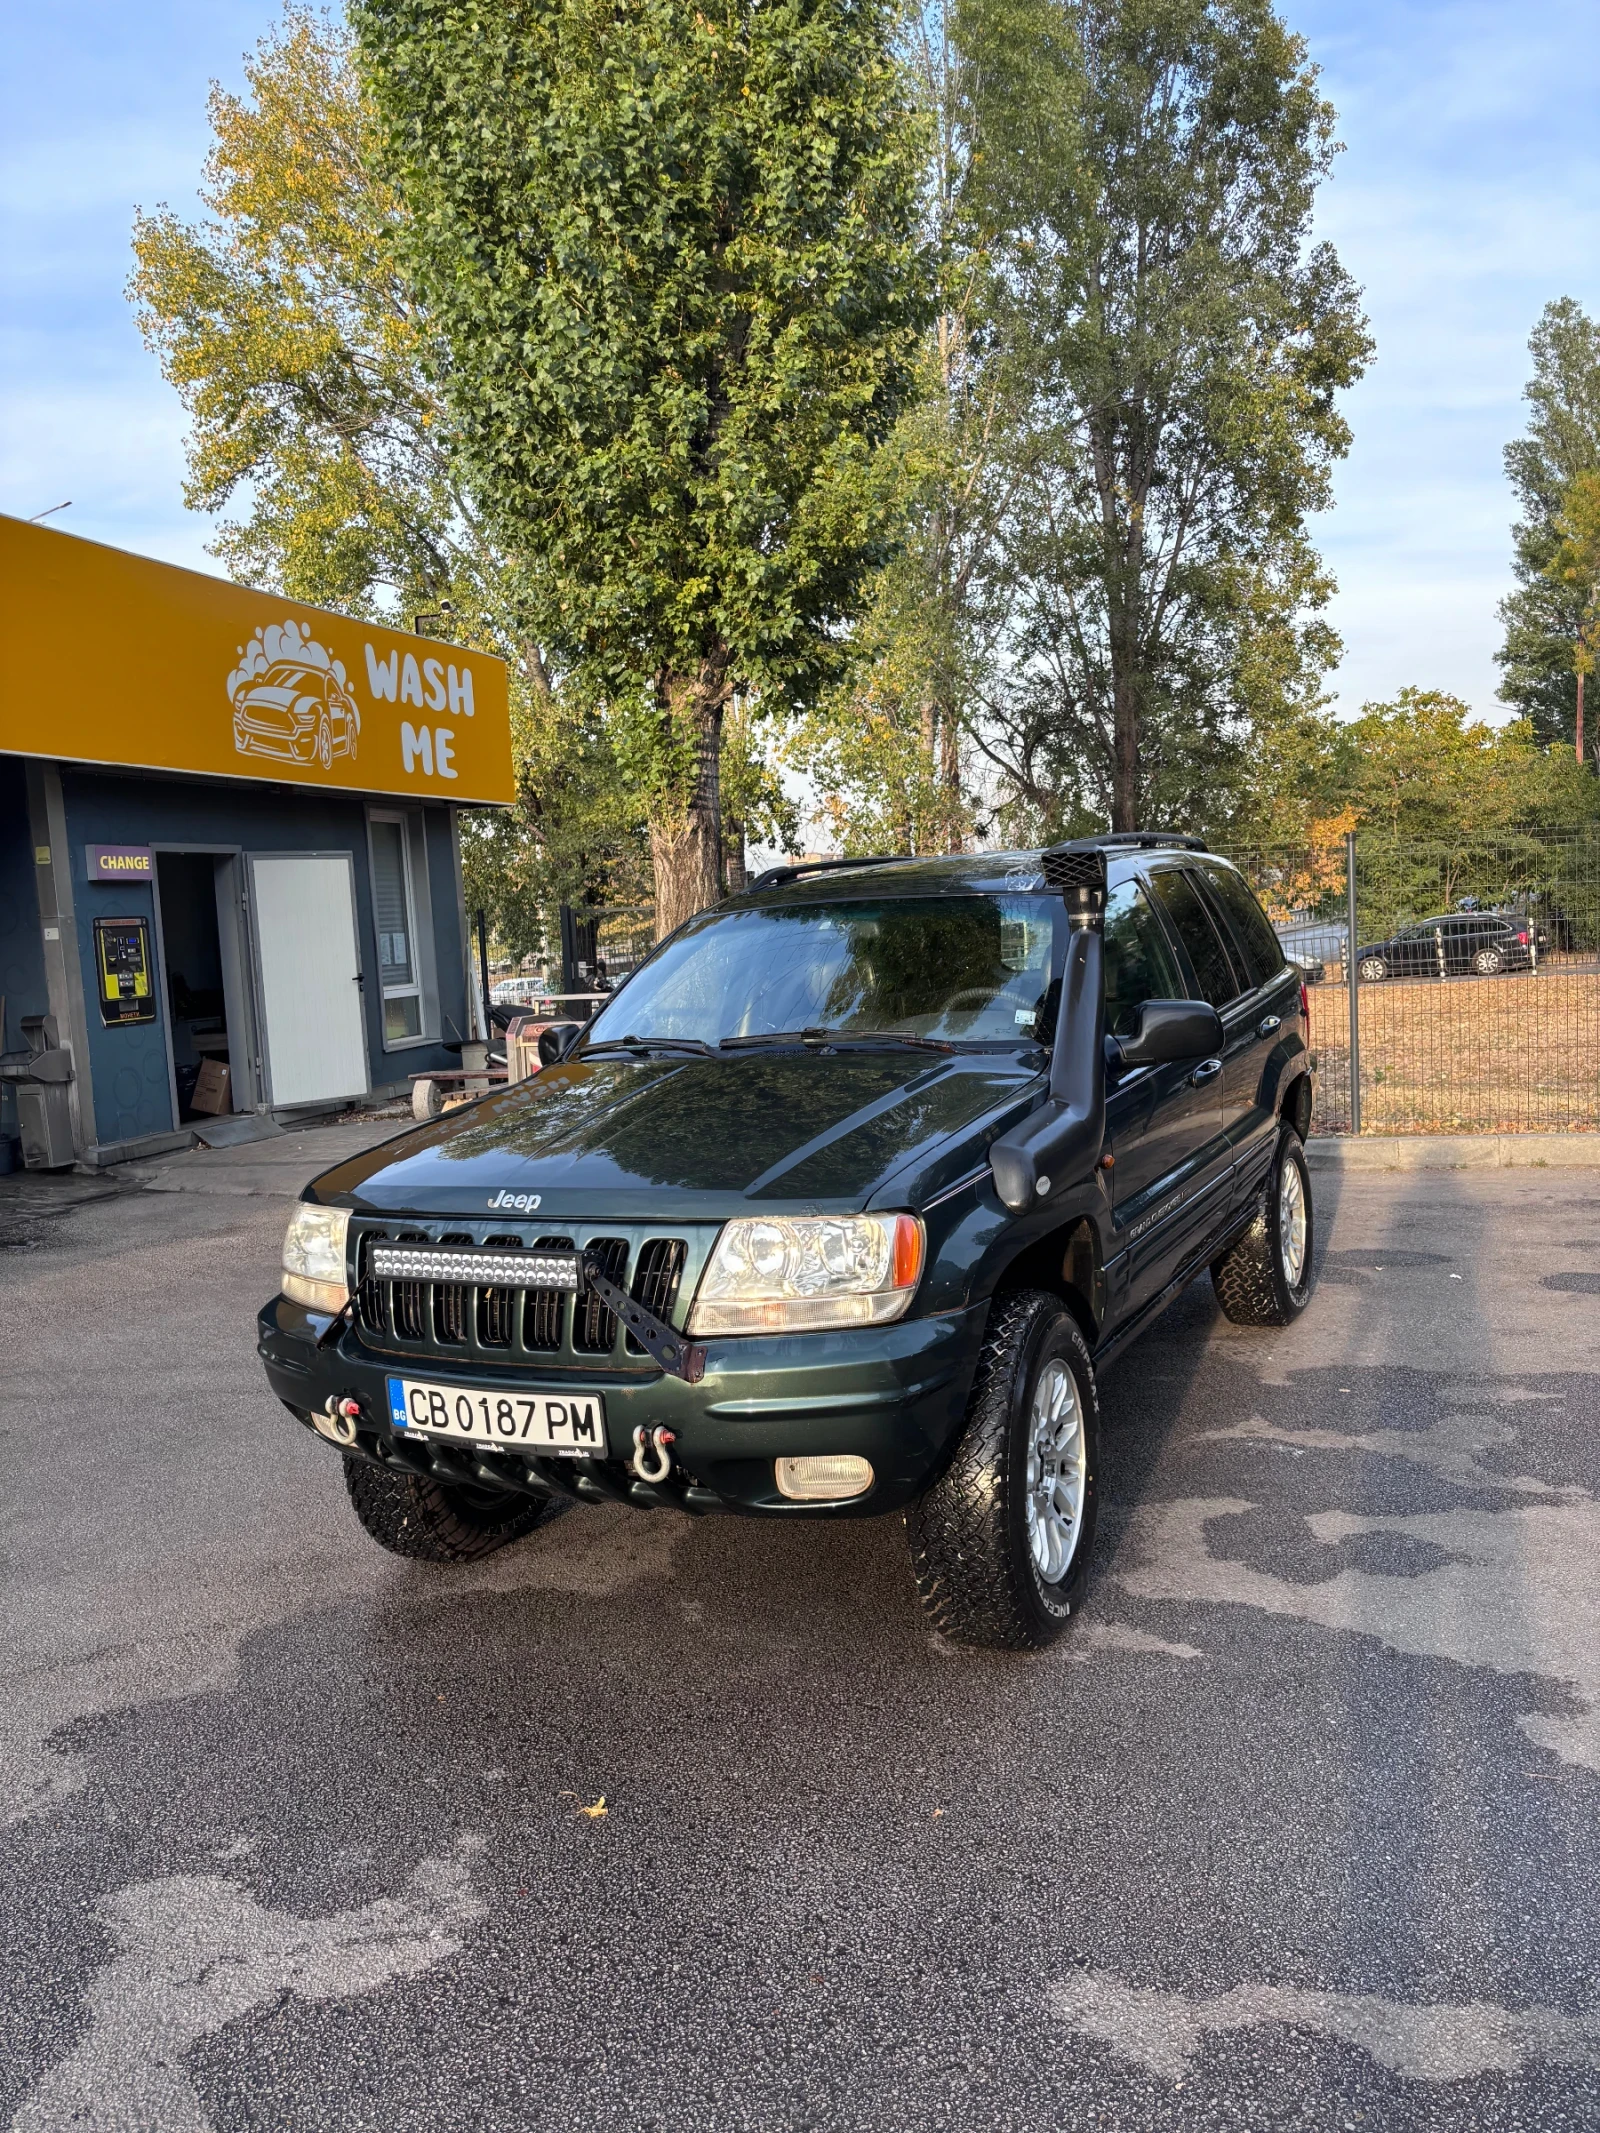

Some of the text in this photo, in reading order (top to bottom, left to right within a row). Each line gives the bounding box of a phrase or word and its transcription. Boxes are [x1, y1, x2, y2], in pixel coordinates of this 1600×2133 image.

[364, 642, 475, 717] WASH
[401, 721, 459, 779] ME
[100, 855, 150, 870] CHANGE
[487, 1189, 542, 1214] Jeep
[1071, 1331, 1100, 1413] GRIPMAX
[393, 1409, 406, 1421] BG
[409, 1388, 596, 1442] CB 0187 PM
[1029, 1551, 1071, 1617] INCEPTION
